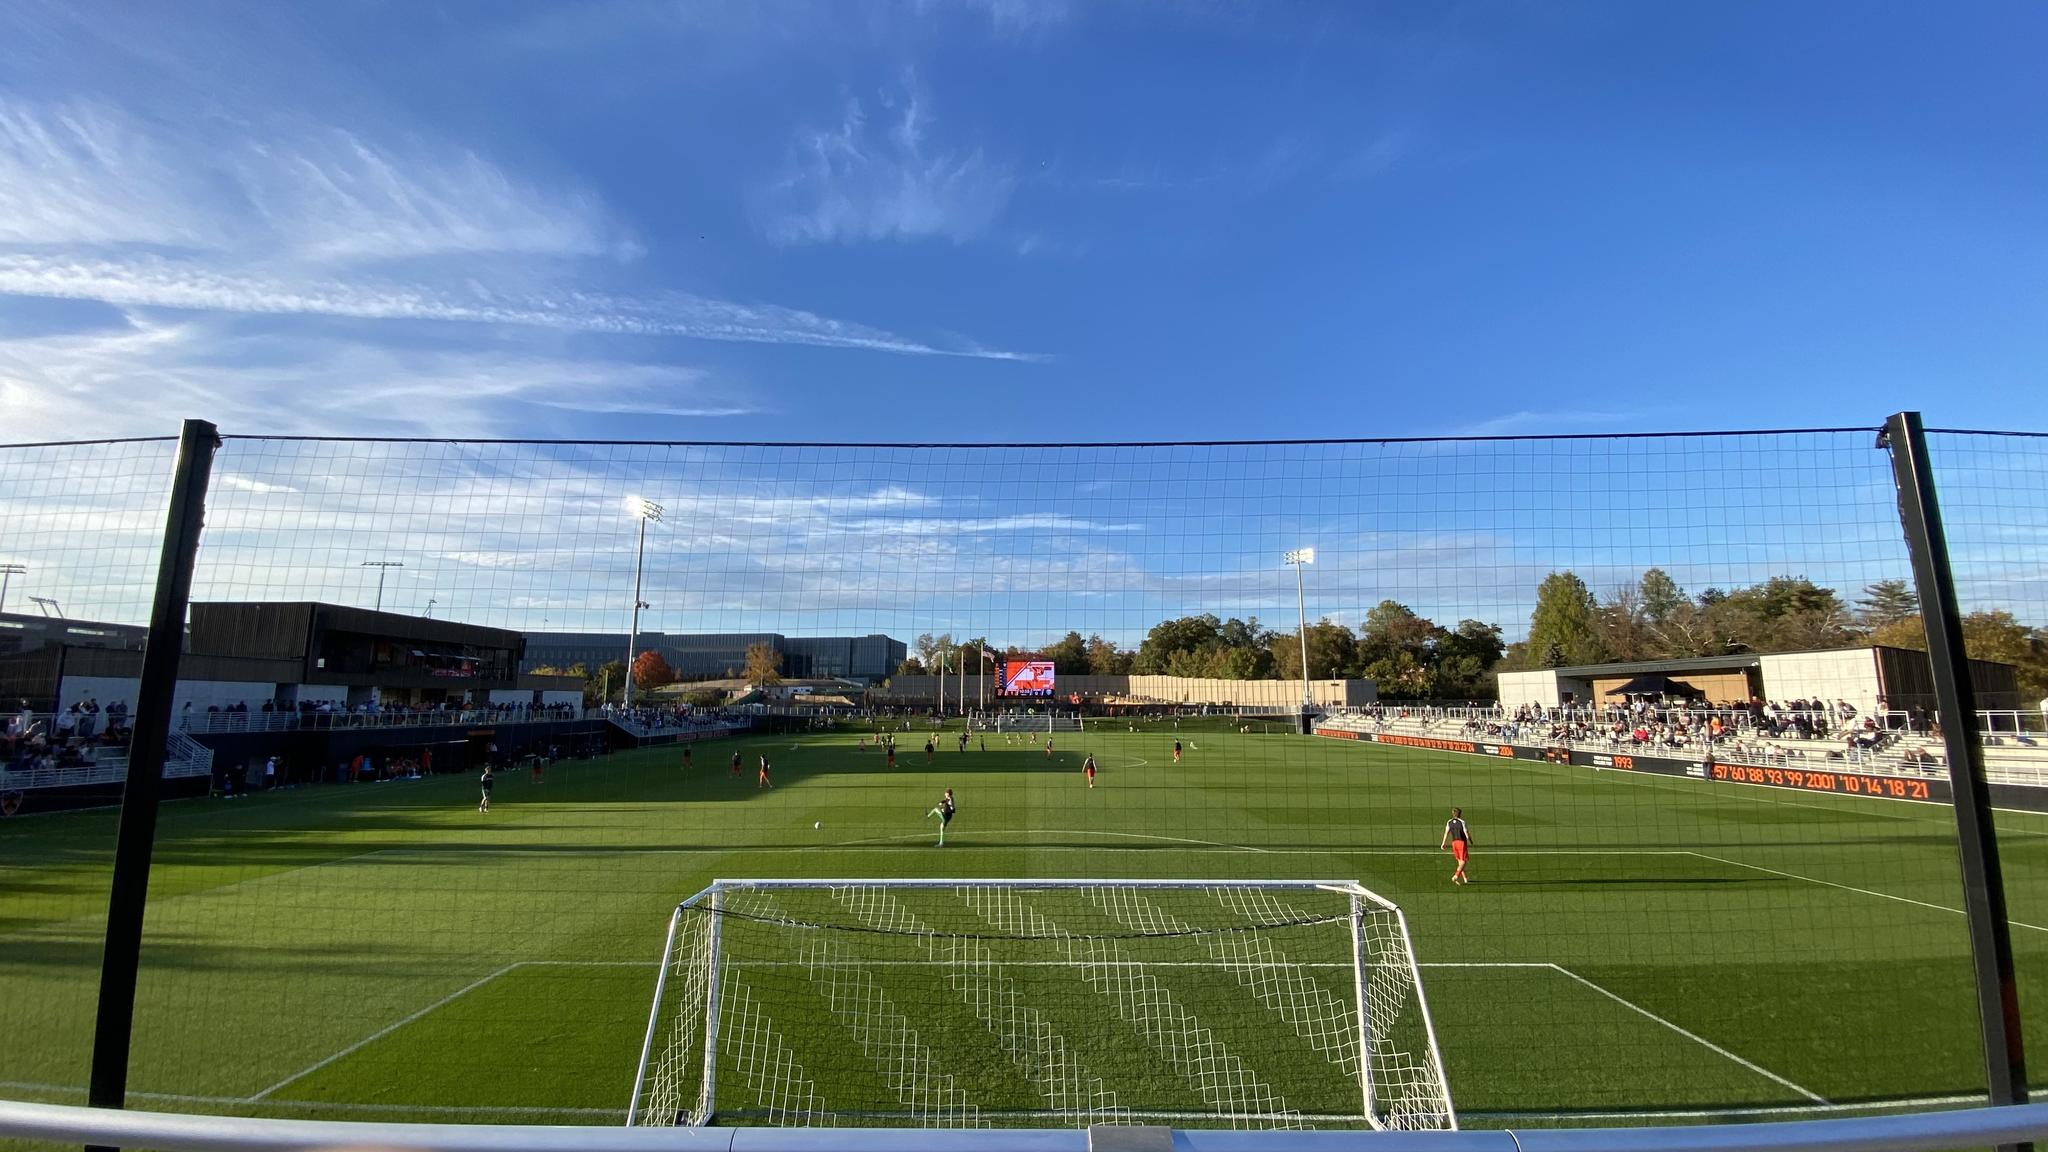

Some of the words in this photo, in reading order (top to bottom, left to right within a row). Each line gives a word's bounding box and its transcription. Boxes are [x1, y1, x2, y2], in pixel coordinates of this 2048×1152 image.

[1614, 756, 1632, 769] 1993
[1729, 766, 1745, 781] '60
[1746, 767, 1764, 782] '88
[1764, 769, 1783, 785] '93
[1784, 770, 1803, 786] '99
[1805, 773, 1836, 790] 2001
[1839, 775, 1859, 792] '10
[1861, 777, 1882, 794] '14
[1883, 778, 1905, 796] '18
[1907, 780, 1928, 798] '21
